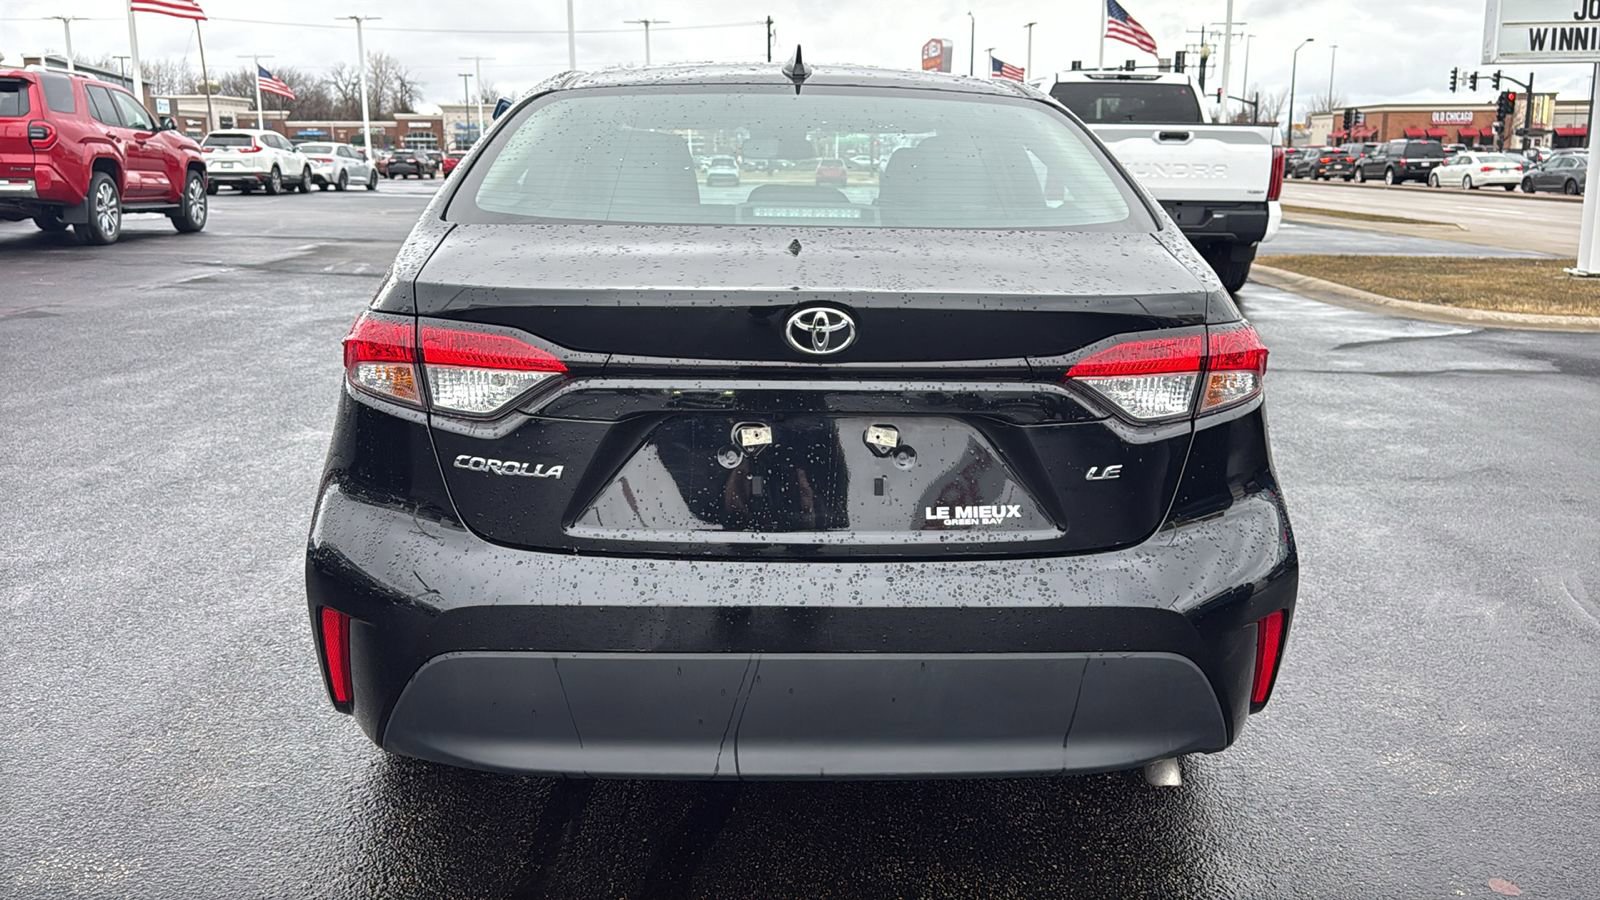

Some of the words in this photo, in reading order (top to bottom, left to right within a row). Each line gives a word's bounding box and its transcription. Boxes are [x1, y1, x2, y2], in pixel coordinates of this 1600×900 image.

[1529, 27, 1600, 51] WINNI
[453, 454, 564, 479] COROLLA
[1085, 464, 1123, 480] LE
[925, 506, 950, 520] LE
[955, 504, 1022, 519] MIEUX
[943, 518, 979, 526] GREEN
[982, 517, 1004, 525] BAY
